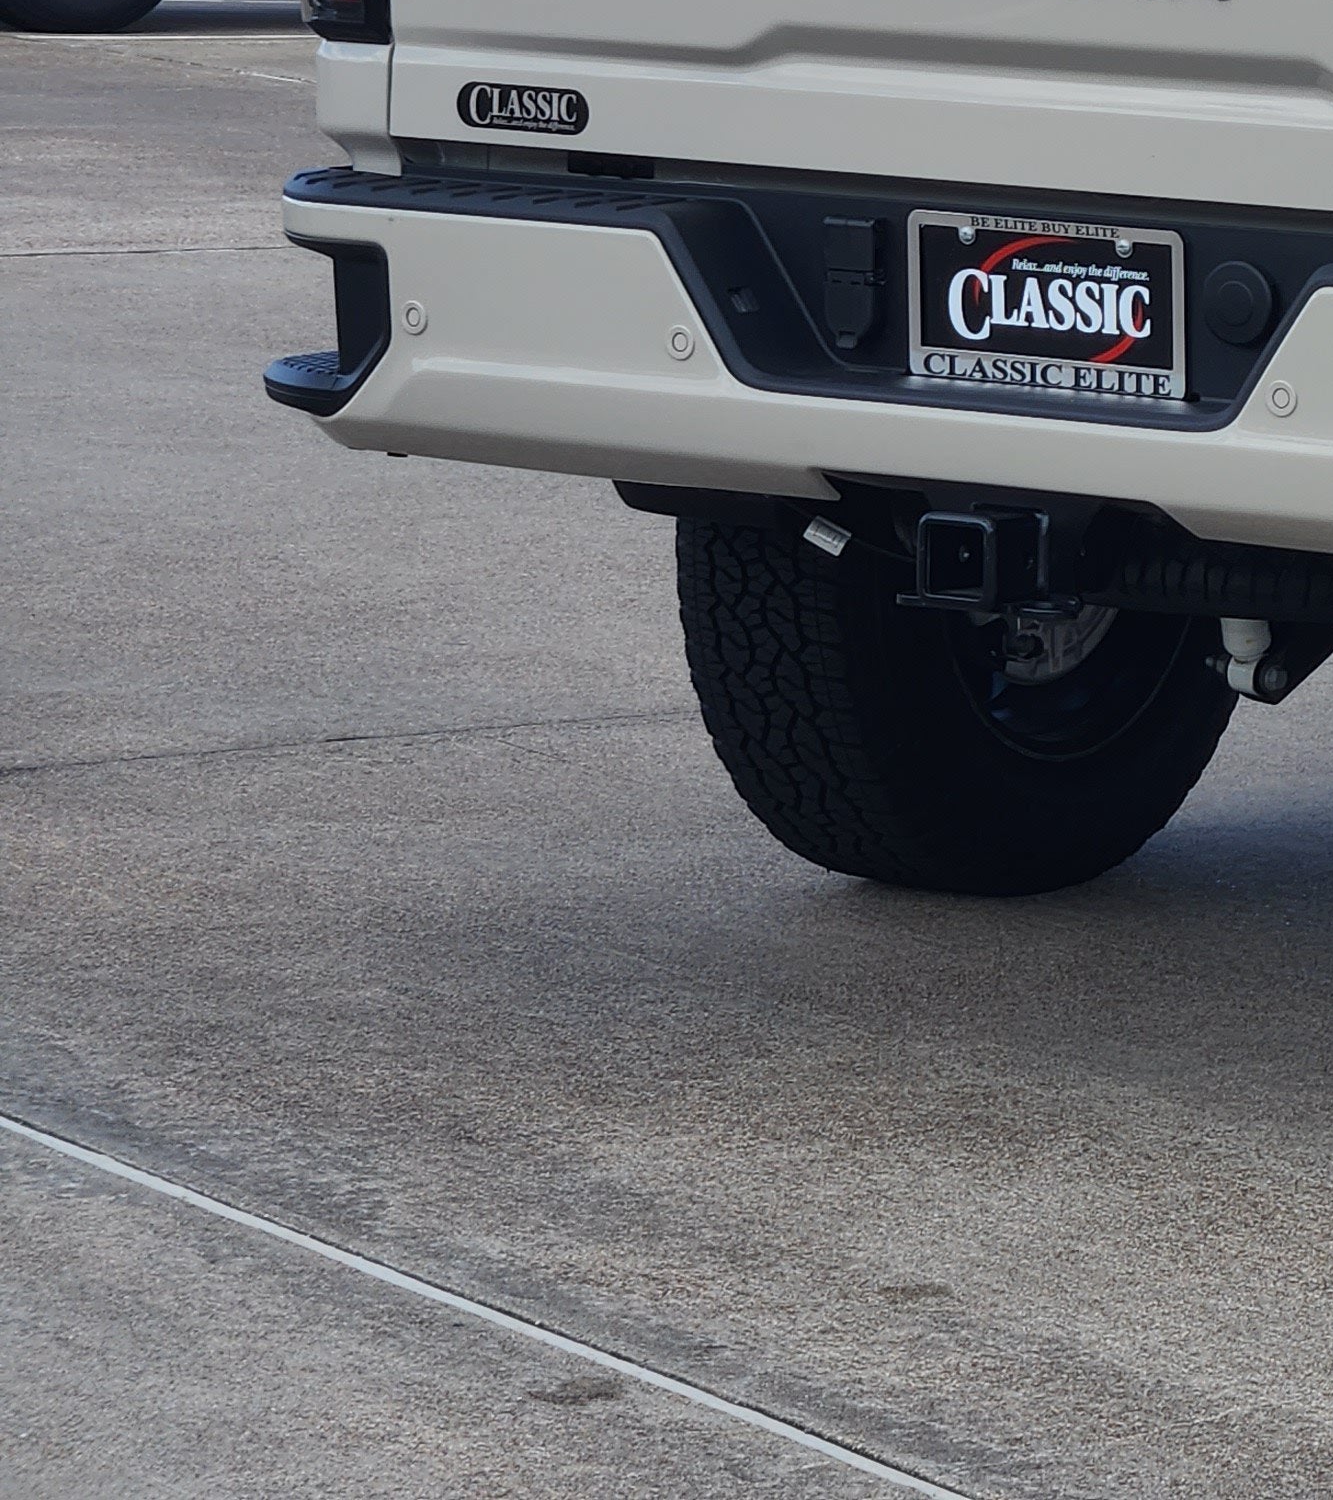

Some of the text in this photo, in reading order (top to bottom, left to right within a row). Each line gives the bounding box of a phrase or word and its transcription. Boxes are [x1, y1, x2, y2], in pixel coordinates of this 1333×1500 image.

[469, 84, 578, 125] CLASSIC
[970, 216, 1120, 239] BE ELITE BUY ELITE
[1063, 263, 1087, 279] enjoy
[1088, 264, 1102, 276] the
[1104, 265, 1150, 282] difference.
[948, 268, 1151, 340] CLASSIC
[922, 353, 1172, 397] CLASSIC ELITE
